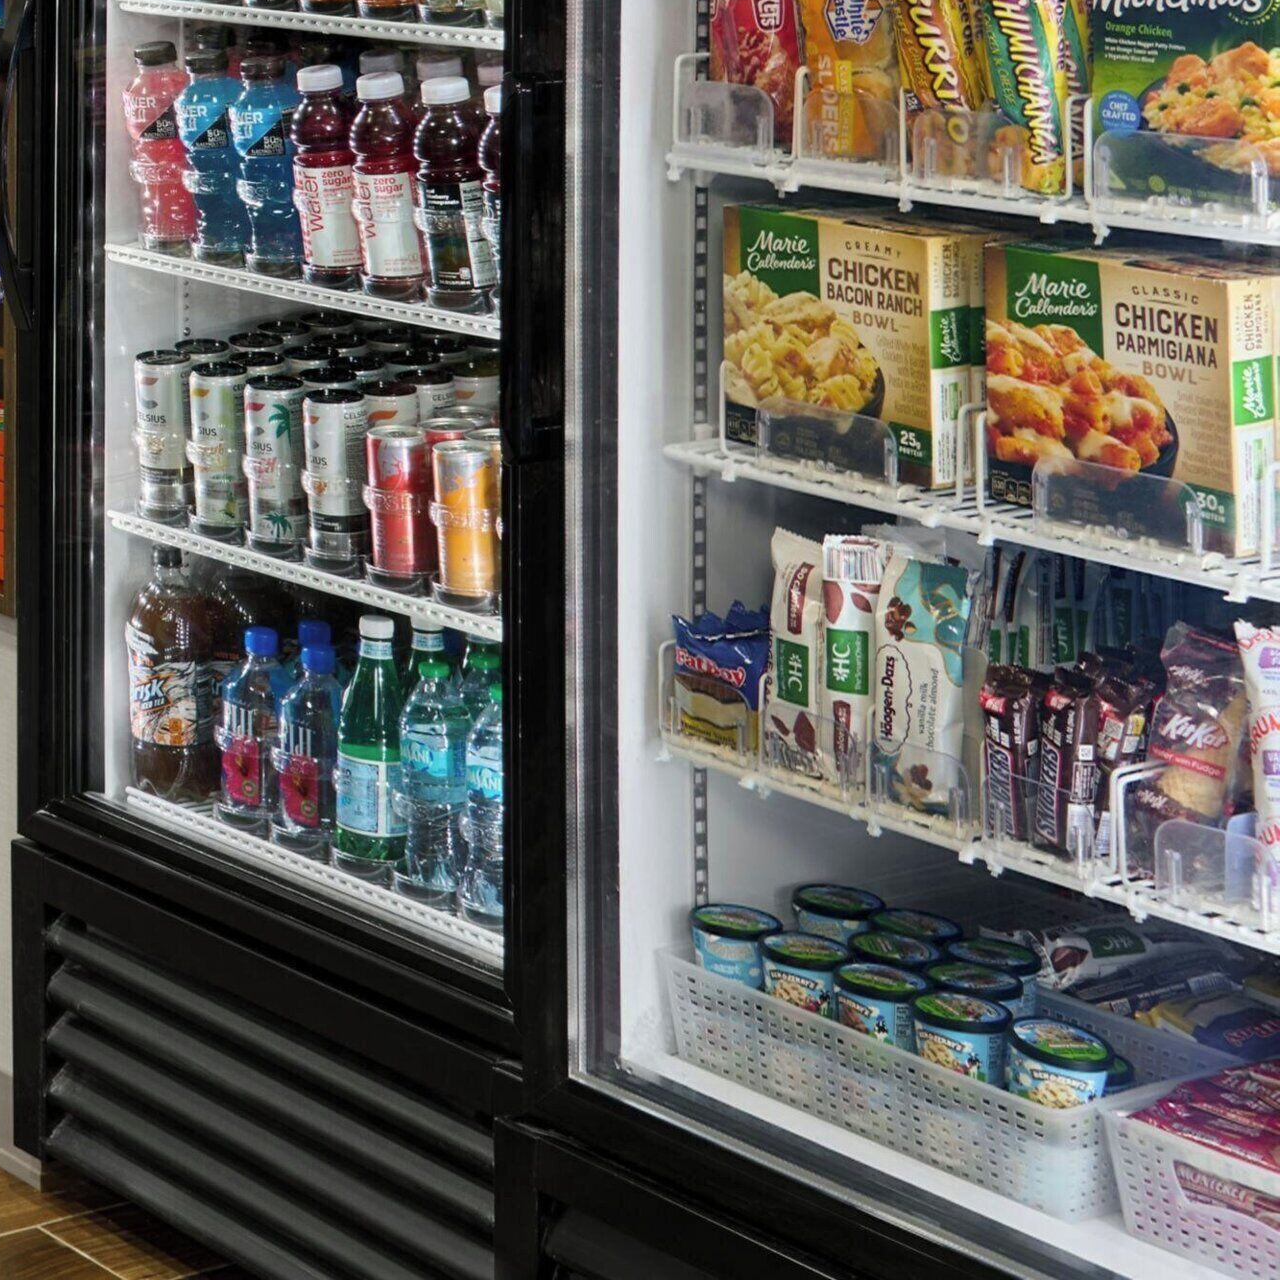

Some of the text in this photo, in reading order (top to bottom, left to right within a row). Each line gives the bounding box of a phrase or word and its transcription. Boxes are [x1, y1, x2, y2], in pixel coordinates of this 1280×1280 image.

[1105, 22, 1173, 38] Orange Chicken
[1102, 109, 1137, 122] CRAFTED
[1109, 101, 1129, 111] CHEF
[321, 170, 344, 179] zero
[322, 176, 352, 187] sugar
[373, 176, 396, 185] zero
[374, 183, 404, 194] sugar
[747, 229, 811, 255] Marie
[845, 240, 902, 258] CREAMY
[747, 252, 816, 272] Callender's
[827, 256, 921, 296] CHICKEN
[1014, 271, 1092, 299] Marie
[826, 282, 923, 318] BACON RANCH
[1131, 284, 1200, 306] CLASSIC
[1014, 297, 1099, 319] Callender's
[852, 311, 899, 334] BOWL
[1114, 301, 1219, 344] CHICKEN
[1115, 330, 1218, 370] PARMIGIANA
[1142, 360, 1197, 386] BOWL
[899, 429, 922, 449] 25g
[898, 445, 924, 459] PROTEIN
